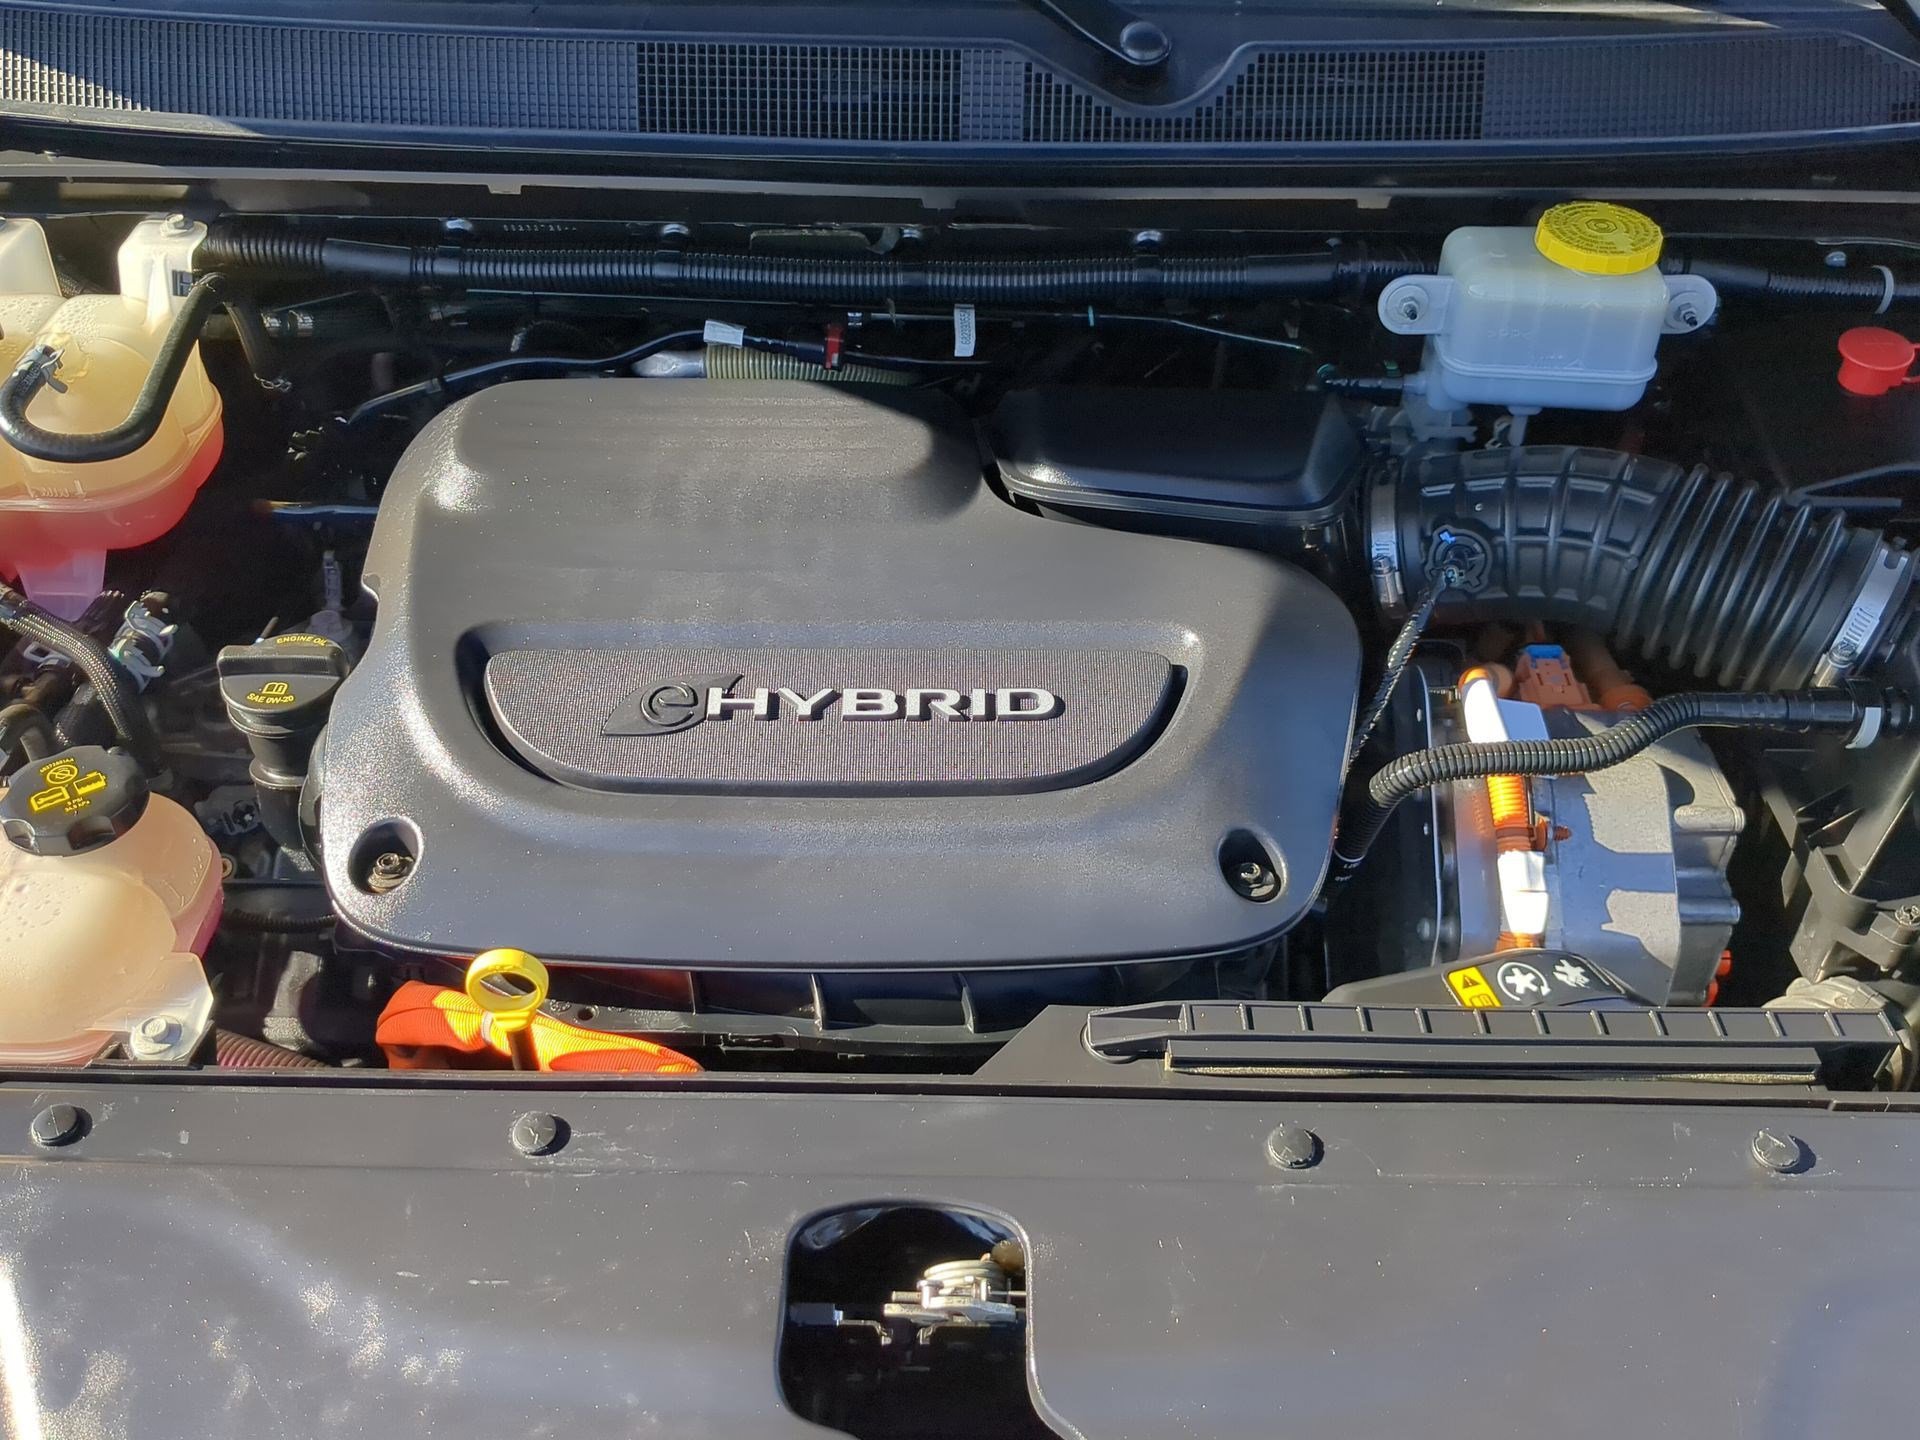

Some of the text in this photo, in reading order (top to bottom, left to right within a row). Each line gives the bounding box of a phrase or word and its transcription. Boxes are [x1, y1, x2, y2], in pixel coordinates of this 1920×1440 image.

[276, 635, 328, 647] ENGINE OIL
[246, 693, 294, 704] SAE 0W-20
